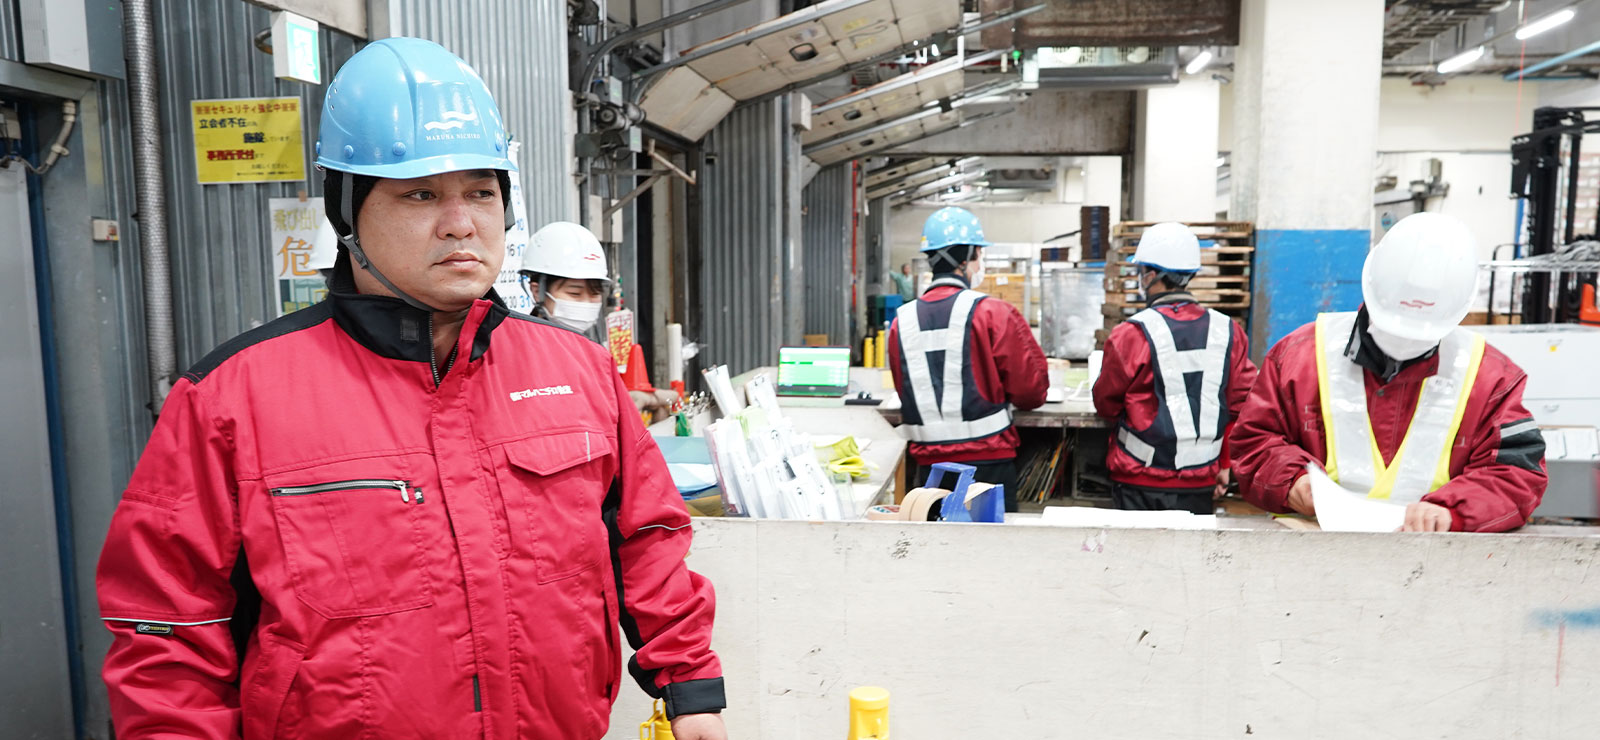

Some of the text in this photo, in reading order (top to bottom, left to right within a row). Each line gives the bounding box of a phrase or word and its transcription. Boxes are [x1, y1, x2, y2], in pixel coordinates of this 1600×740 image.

[506, 243, 515, 257] 16
[508, 295, 517, 308] 30
[519, 294, 530, 308] 31
